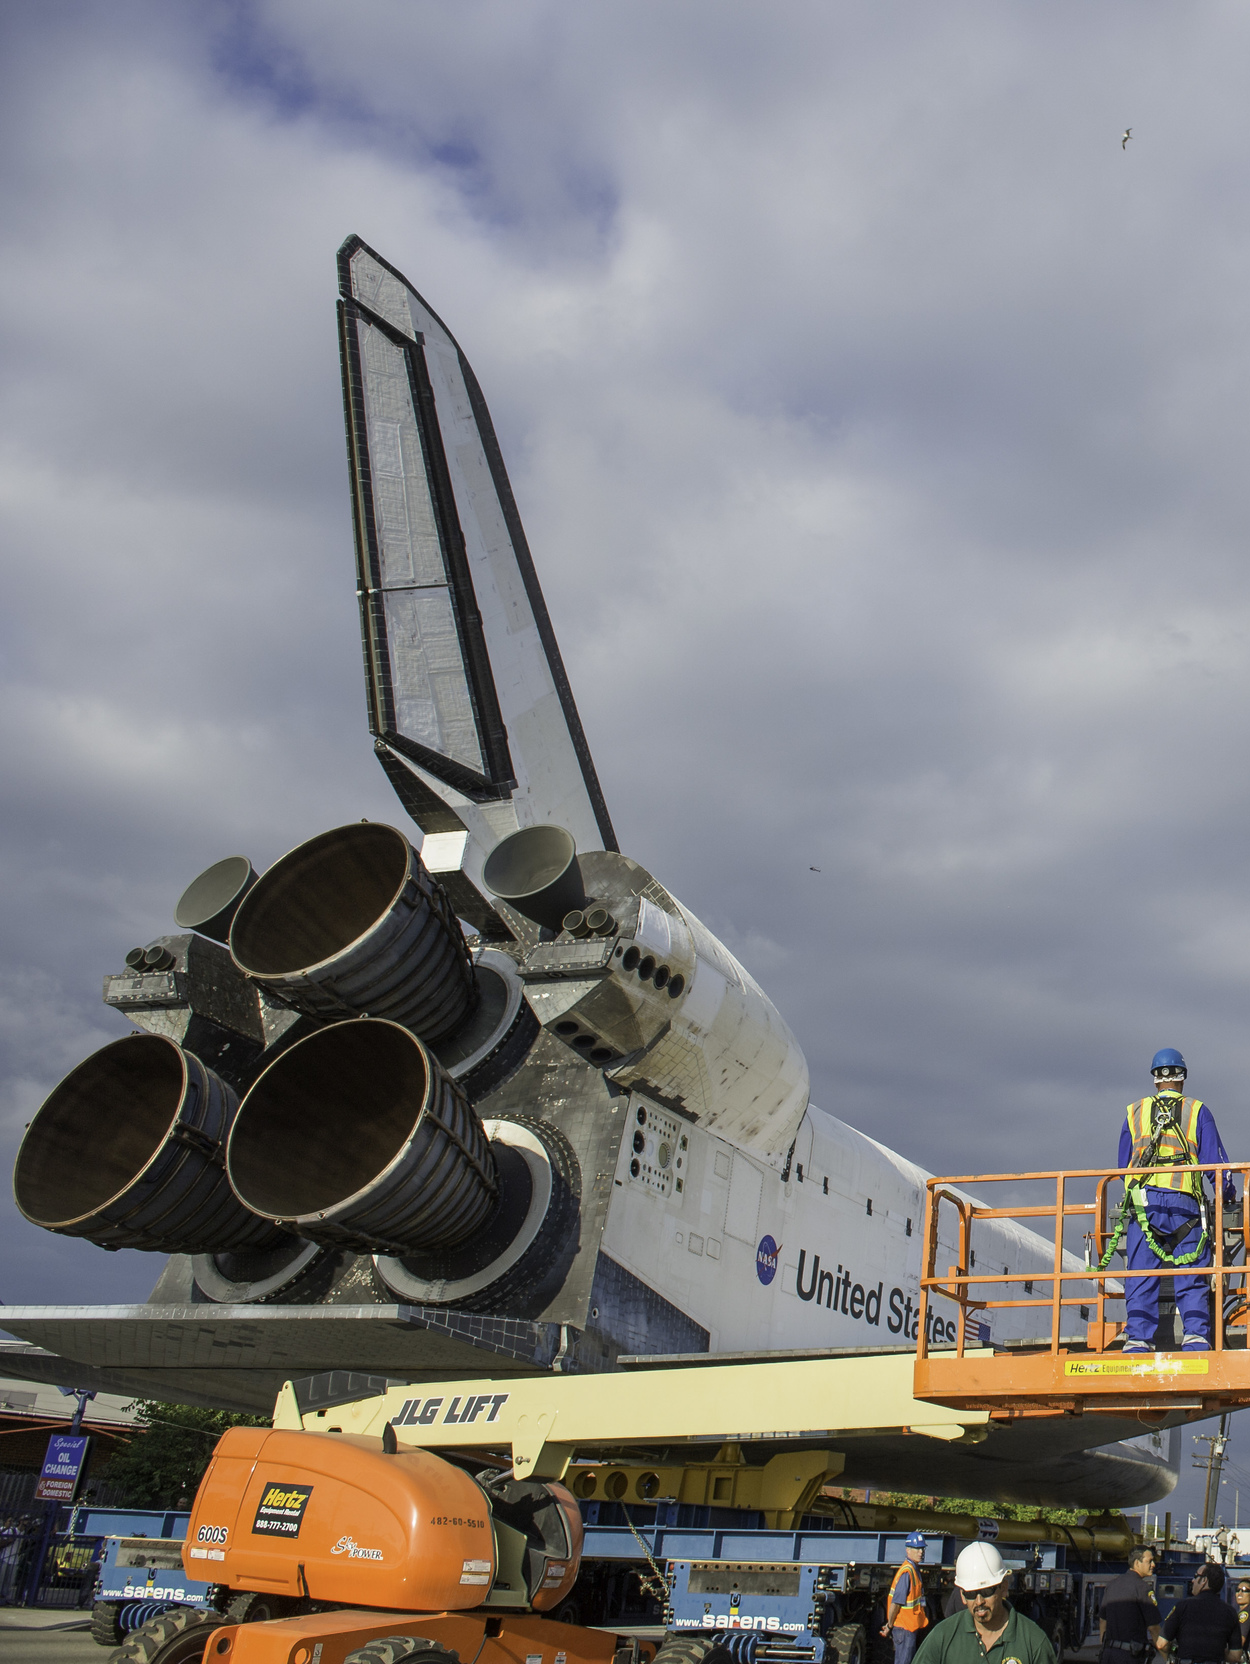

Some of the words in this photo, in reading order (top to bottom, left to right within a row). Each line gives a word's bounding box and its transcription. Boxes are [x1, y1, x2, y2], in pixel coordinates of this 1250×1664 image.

[757, 1250, 776, 1269] NASA
[797, 1249, 883, 1327] United
[391, 1398, 444, 1425] JLG
[443, 1393, 509, 1424] LIFT
[54, 1438, 83, 1450] Special
[58, 1453, 70, 1463] OIL
[45, 1464, 77, 1475] CHANGE
[46, 1481, 73, 1489] FOREIGN
[42, 1489, 72, 1497] DOMESTIC
[262, 1488, 307, 1509] Hertz
[260, 1506, 284, 1515] Equipment
[284, 1509, 301, 1517] Rental
[256, 1520, 298, 1532] 888-777-2700
[431, 1517, 485, 1528] 482-60-5510
[198, 1526, 228, 1543] 600S
[103, 1585, 203, 1602] www.sarens.com
[676, 1614, 805, 1632] www.sarens.com
